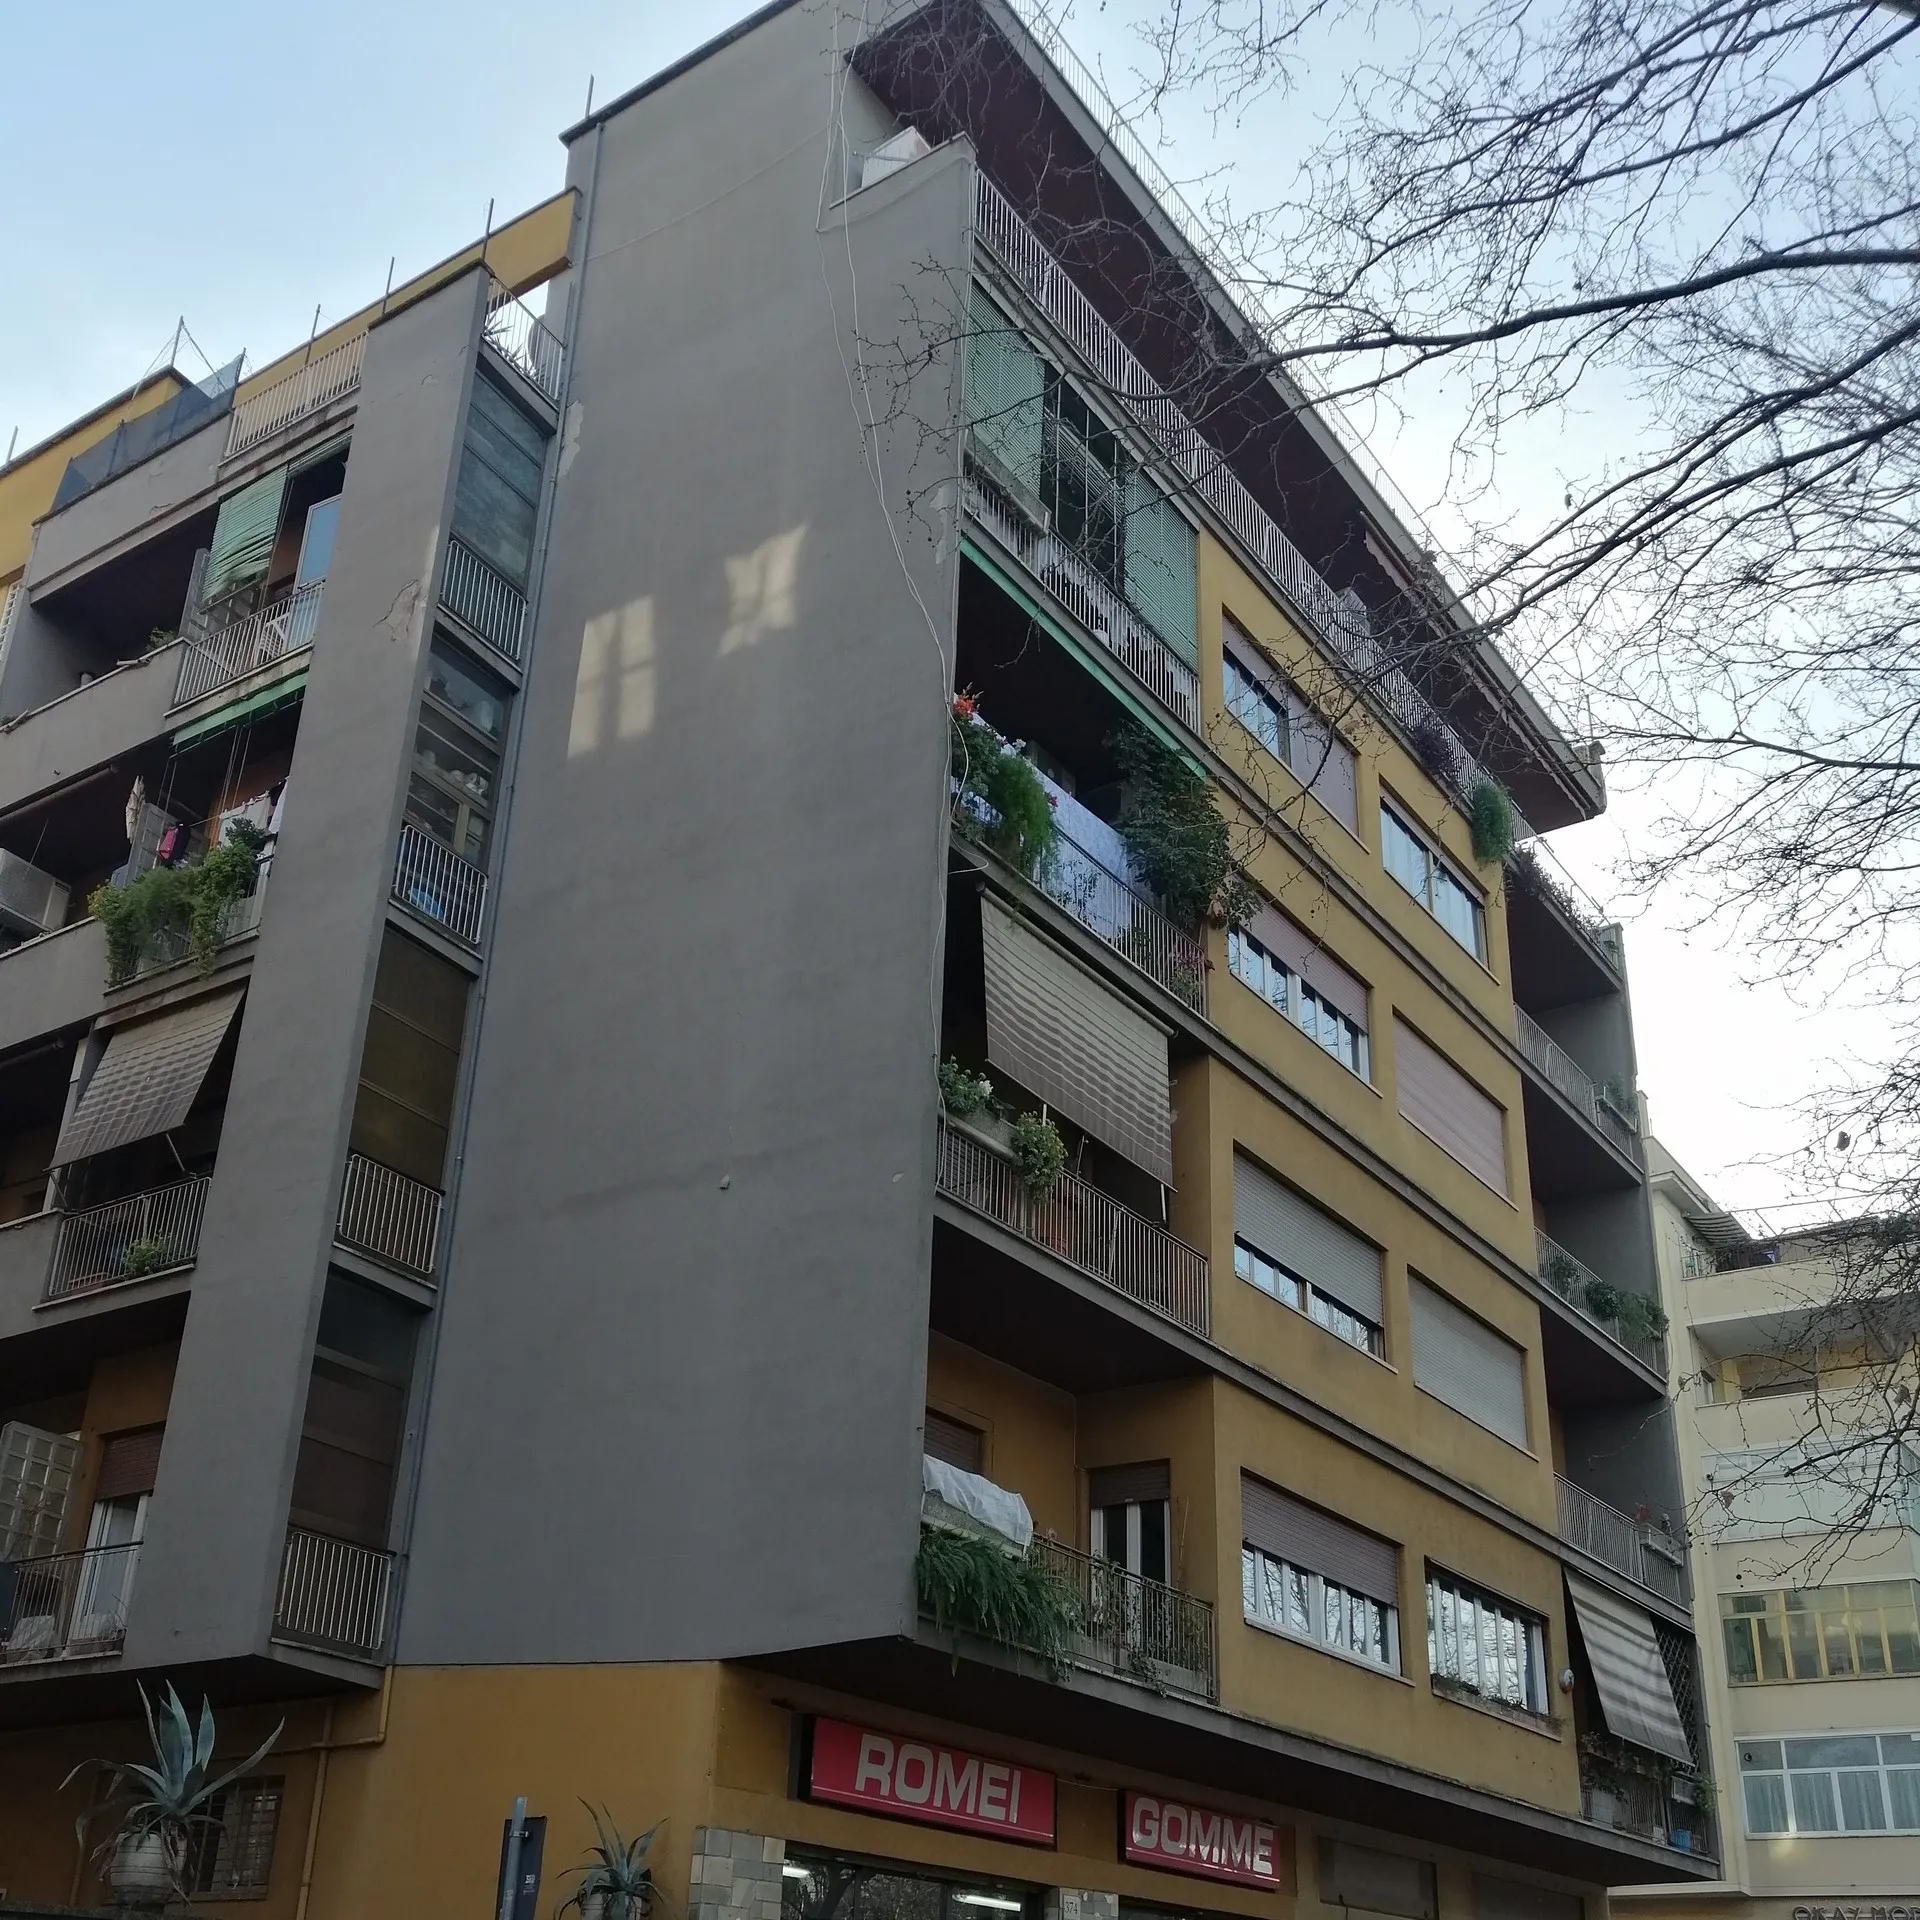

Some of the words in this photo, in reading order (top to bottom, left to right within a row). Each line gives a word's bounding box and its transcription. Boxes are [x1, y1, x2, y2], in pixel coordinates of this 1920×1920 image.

[855, 1733, 1021, 1823] ROMEI
[1132, 1797, 1274, 1874] GOMME
[1064, 1901, 1078, 1914] 374
